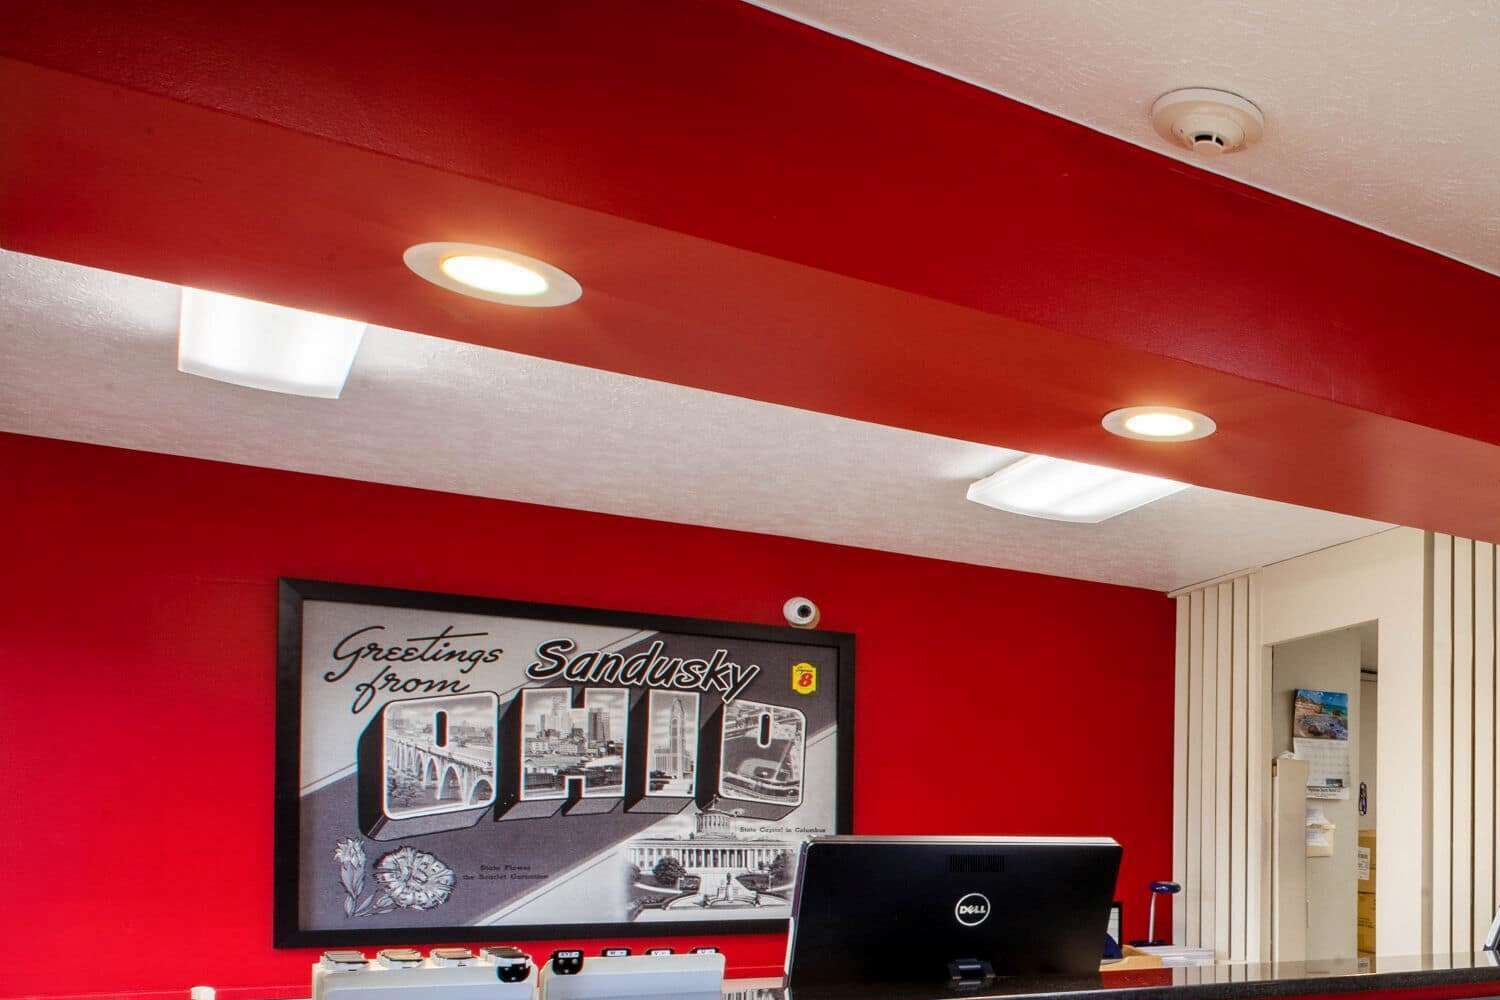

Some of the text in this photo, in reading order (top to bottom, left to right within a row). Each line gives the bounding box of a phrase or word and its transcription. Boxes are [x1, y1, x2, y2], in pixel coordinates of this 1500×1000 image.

[324, 625, 504, 683] Greetings
[525, 638, 760, 704] Sandusky
[351, 664, 471, 715] from
[357, 687, 808, 842] OHIO
[959, 905, 987, 914] DELL
